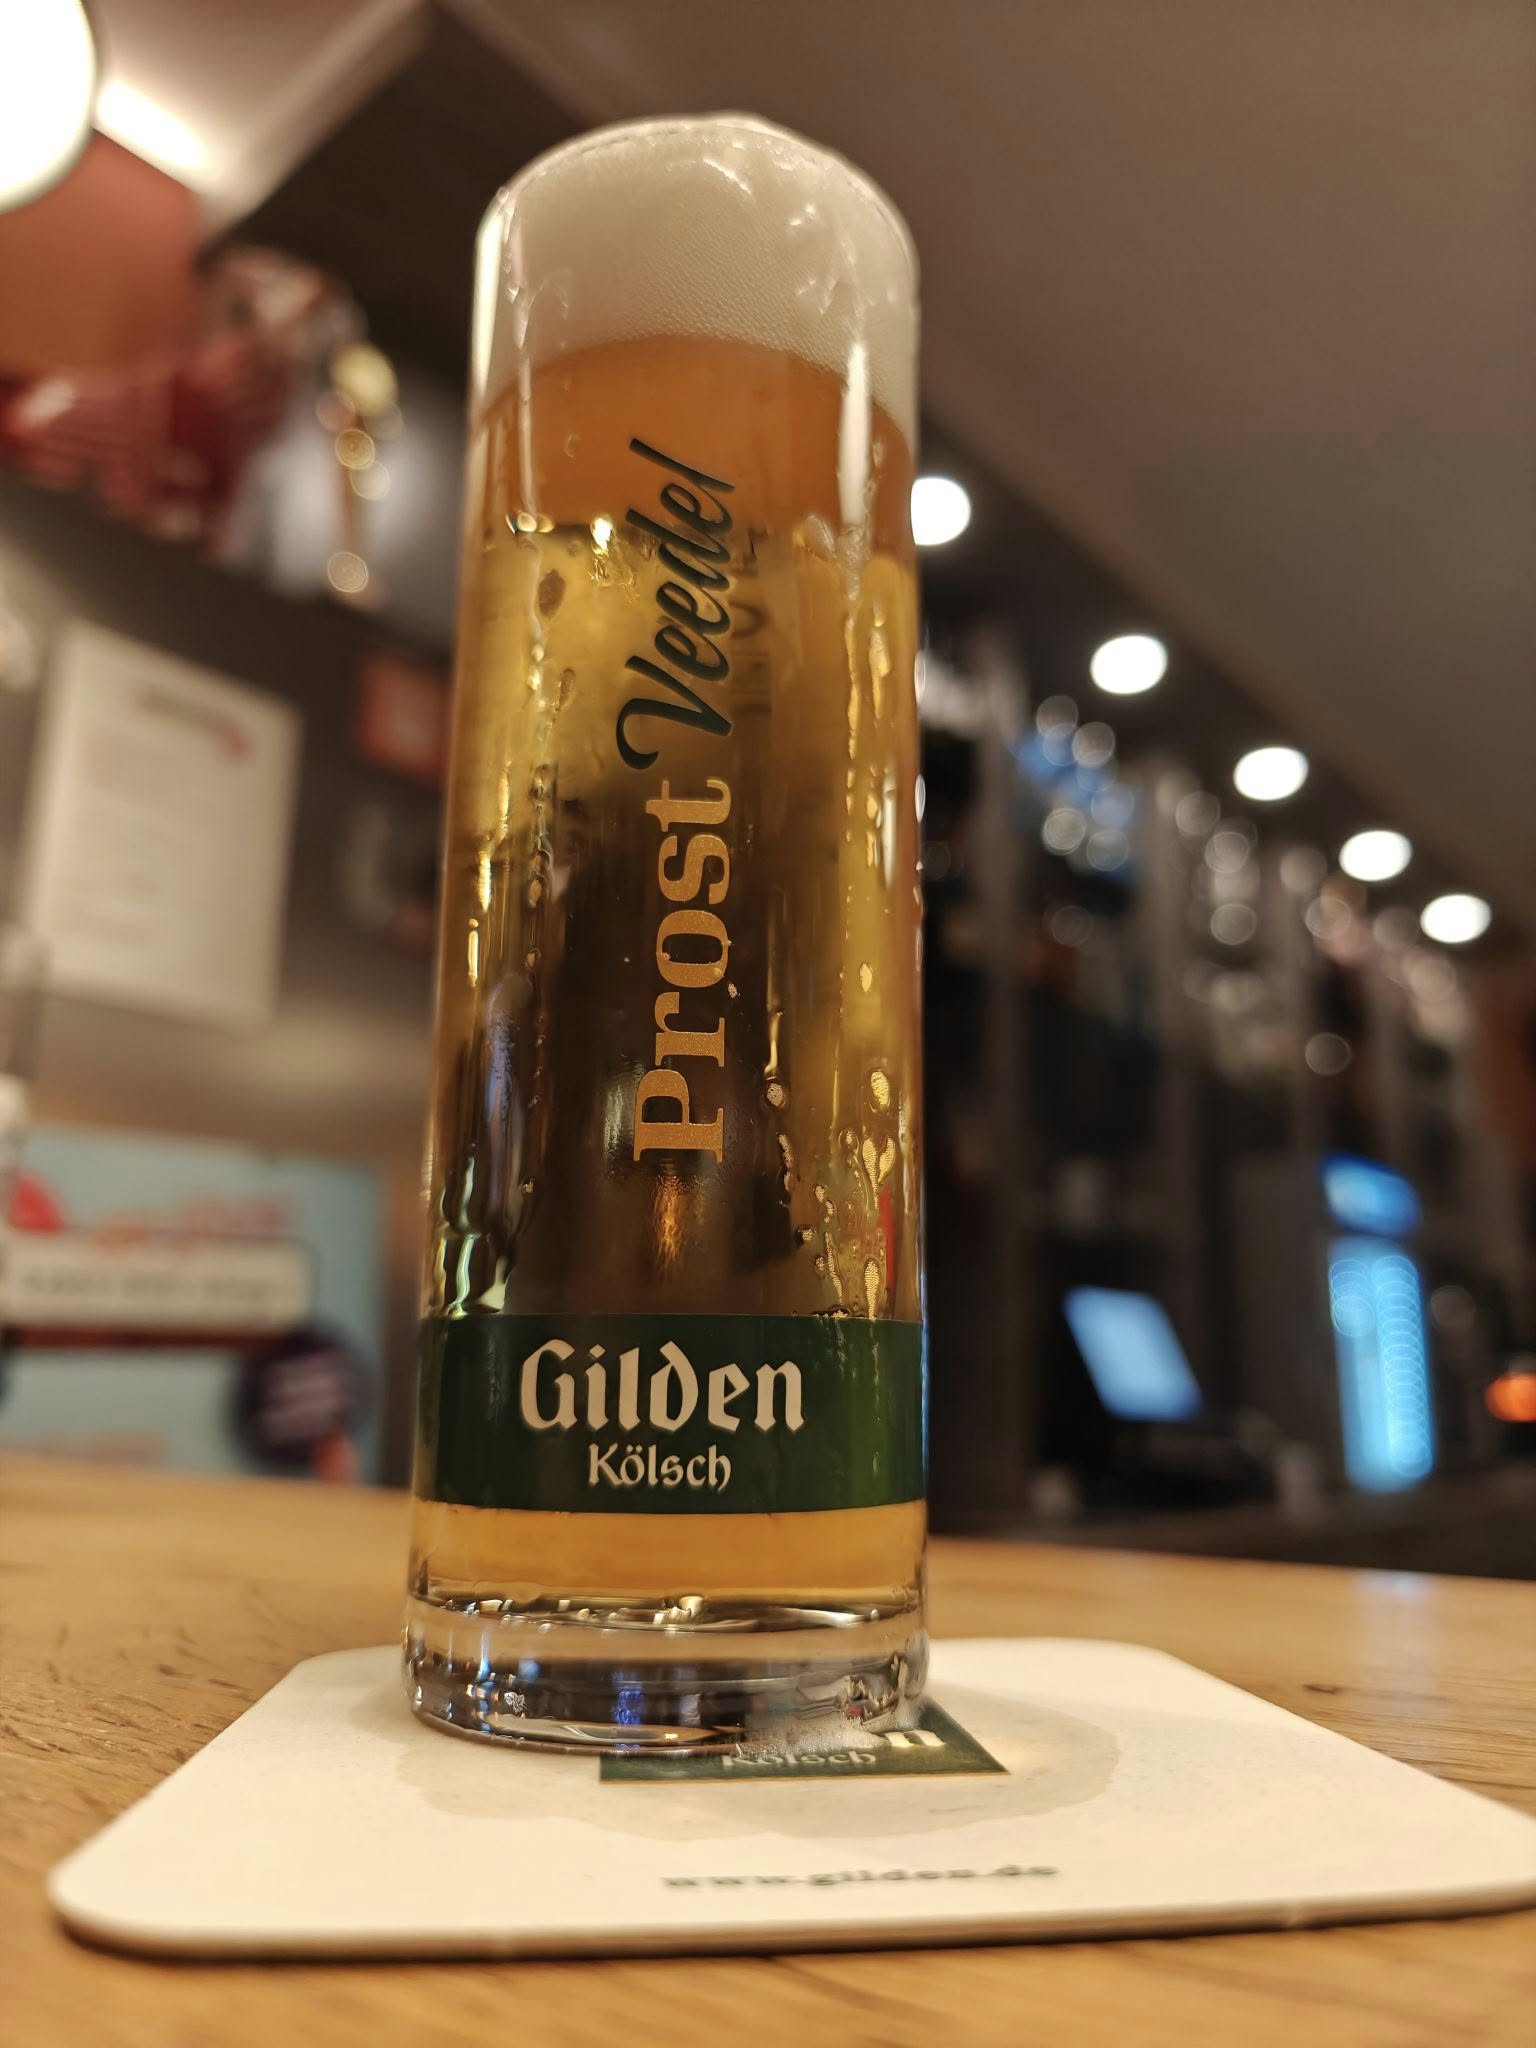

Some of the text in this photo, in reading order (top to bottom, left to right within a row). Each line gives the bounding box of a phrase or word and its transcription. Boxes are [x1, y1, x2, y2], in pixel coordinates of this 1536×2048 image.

[616, 438, 735, 1163] Prost Veedel
[520, 1339, 805, 1433] Gilden
[588, 1443, 732, 1492] Kölsch
[661, 1864, 1058, 1887] www.gilden.de
